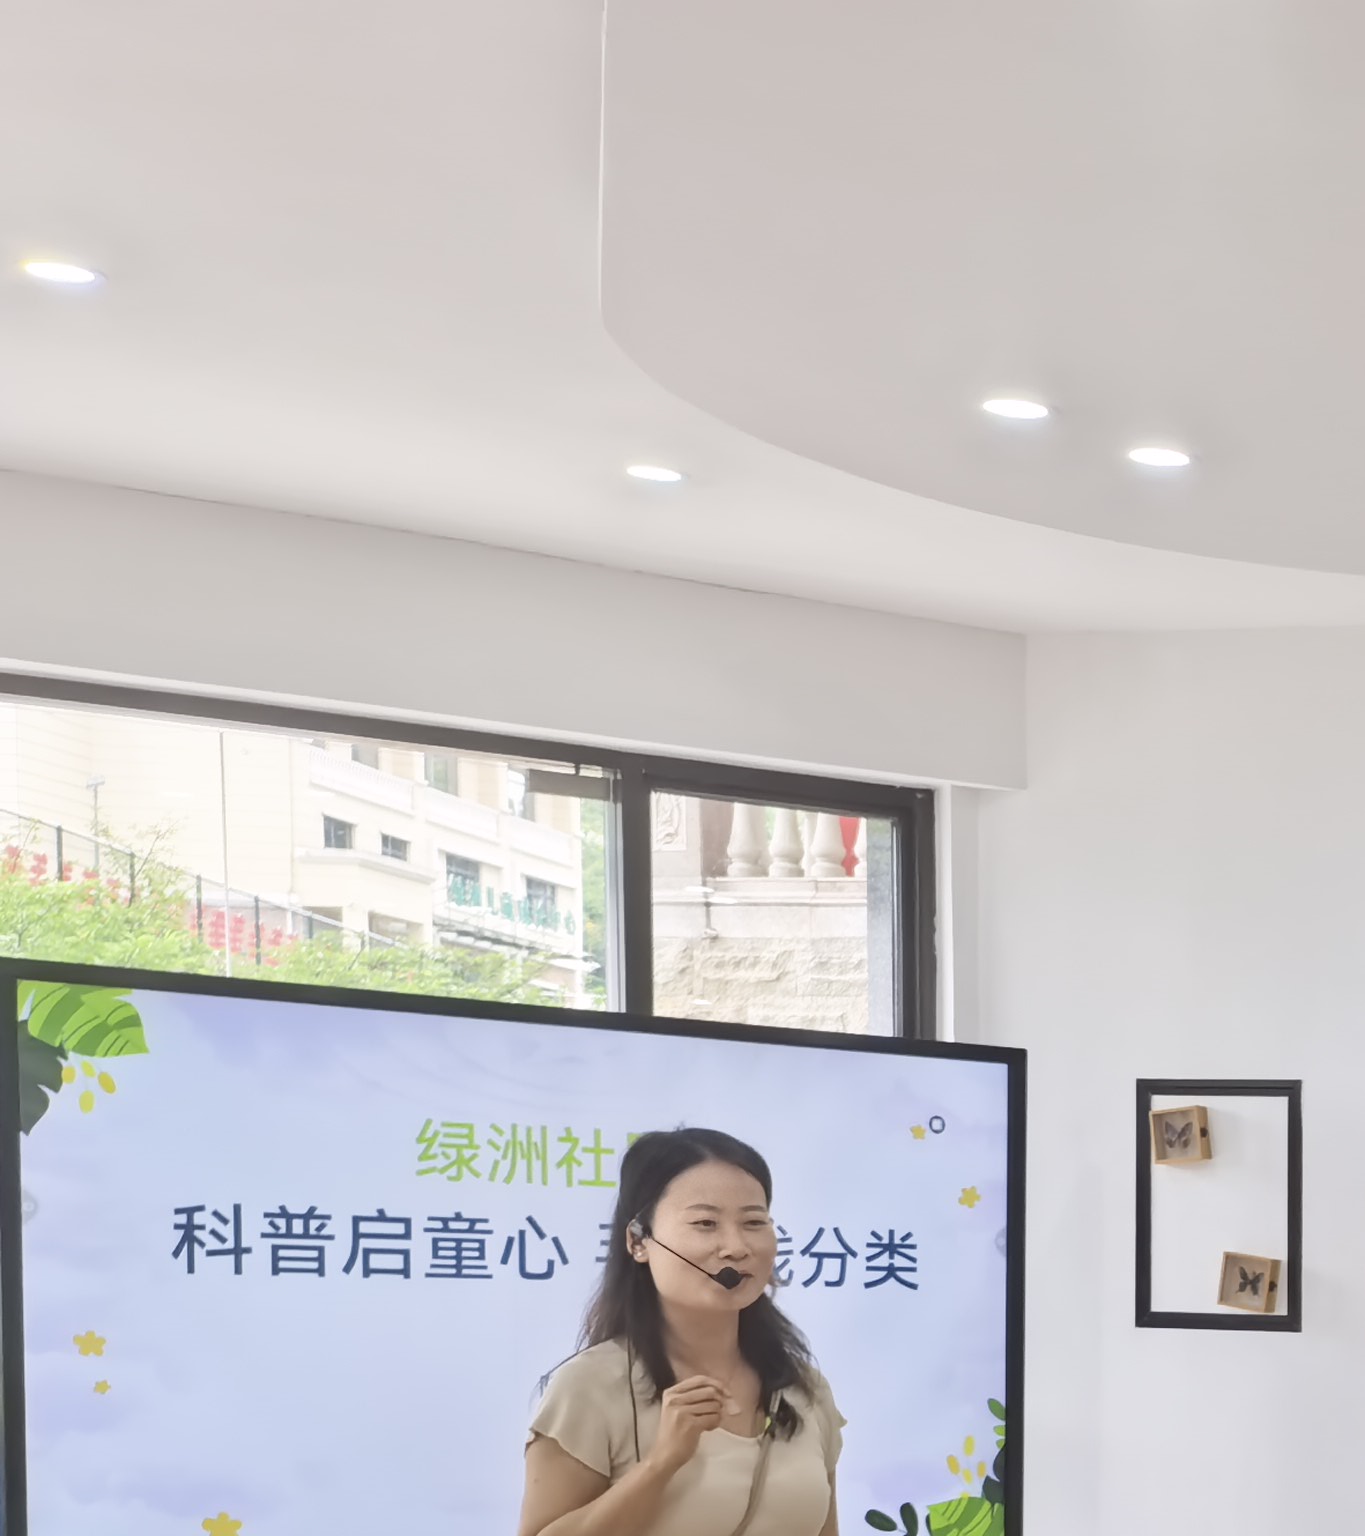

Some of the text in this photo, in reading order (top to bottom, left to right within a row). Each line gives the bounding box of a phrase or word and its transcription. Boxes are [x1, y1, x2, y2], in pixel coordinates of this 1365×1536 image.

[415, 1118, 642, 1188] 绿洲社
[170, 1202, 569, 1281] 科普启童心
